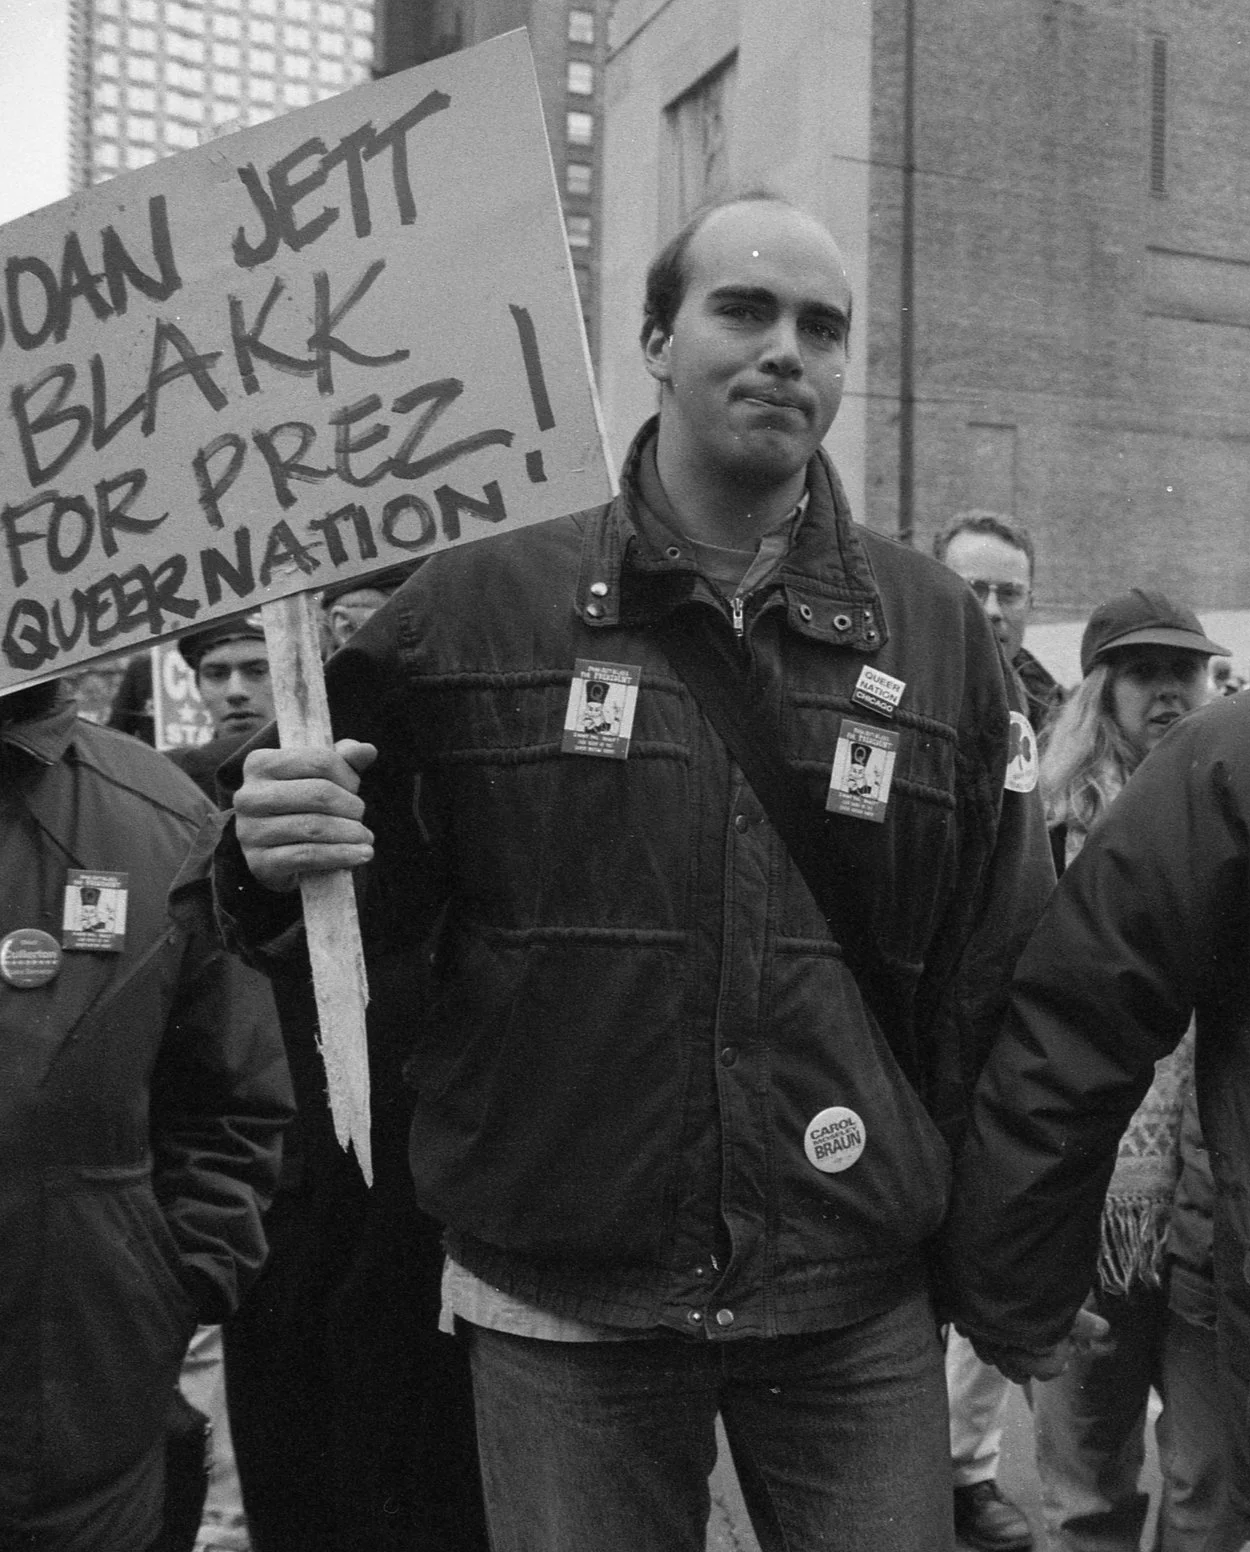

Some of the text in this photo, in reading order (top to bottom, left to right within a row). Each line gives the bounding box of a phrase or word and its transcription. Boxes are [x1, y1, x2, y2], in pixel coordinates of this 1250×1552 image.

[0, 88, 452, 352] OAN JETT
[11, 258, 410, 488] BLAKK
[0, 468, 170, 588] FOR
[1, 553, 200, 672] QUEER
[860, 681, 898, 703] NATION
[864, 671, 901, 692] QUEER
[856, 690, 893, 713] CHICAGO
[810, 1117, 856, 1140] CAROL
[814, 1130, 862, 1159] BRAUN
